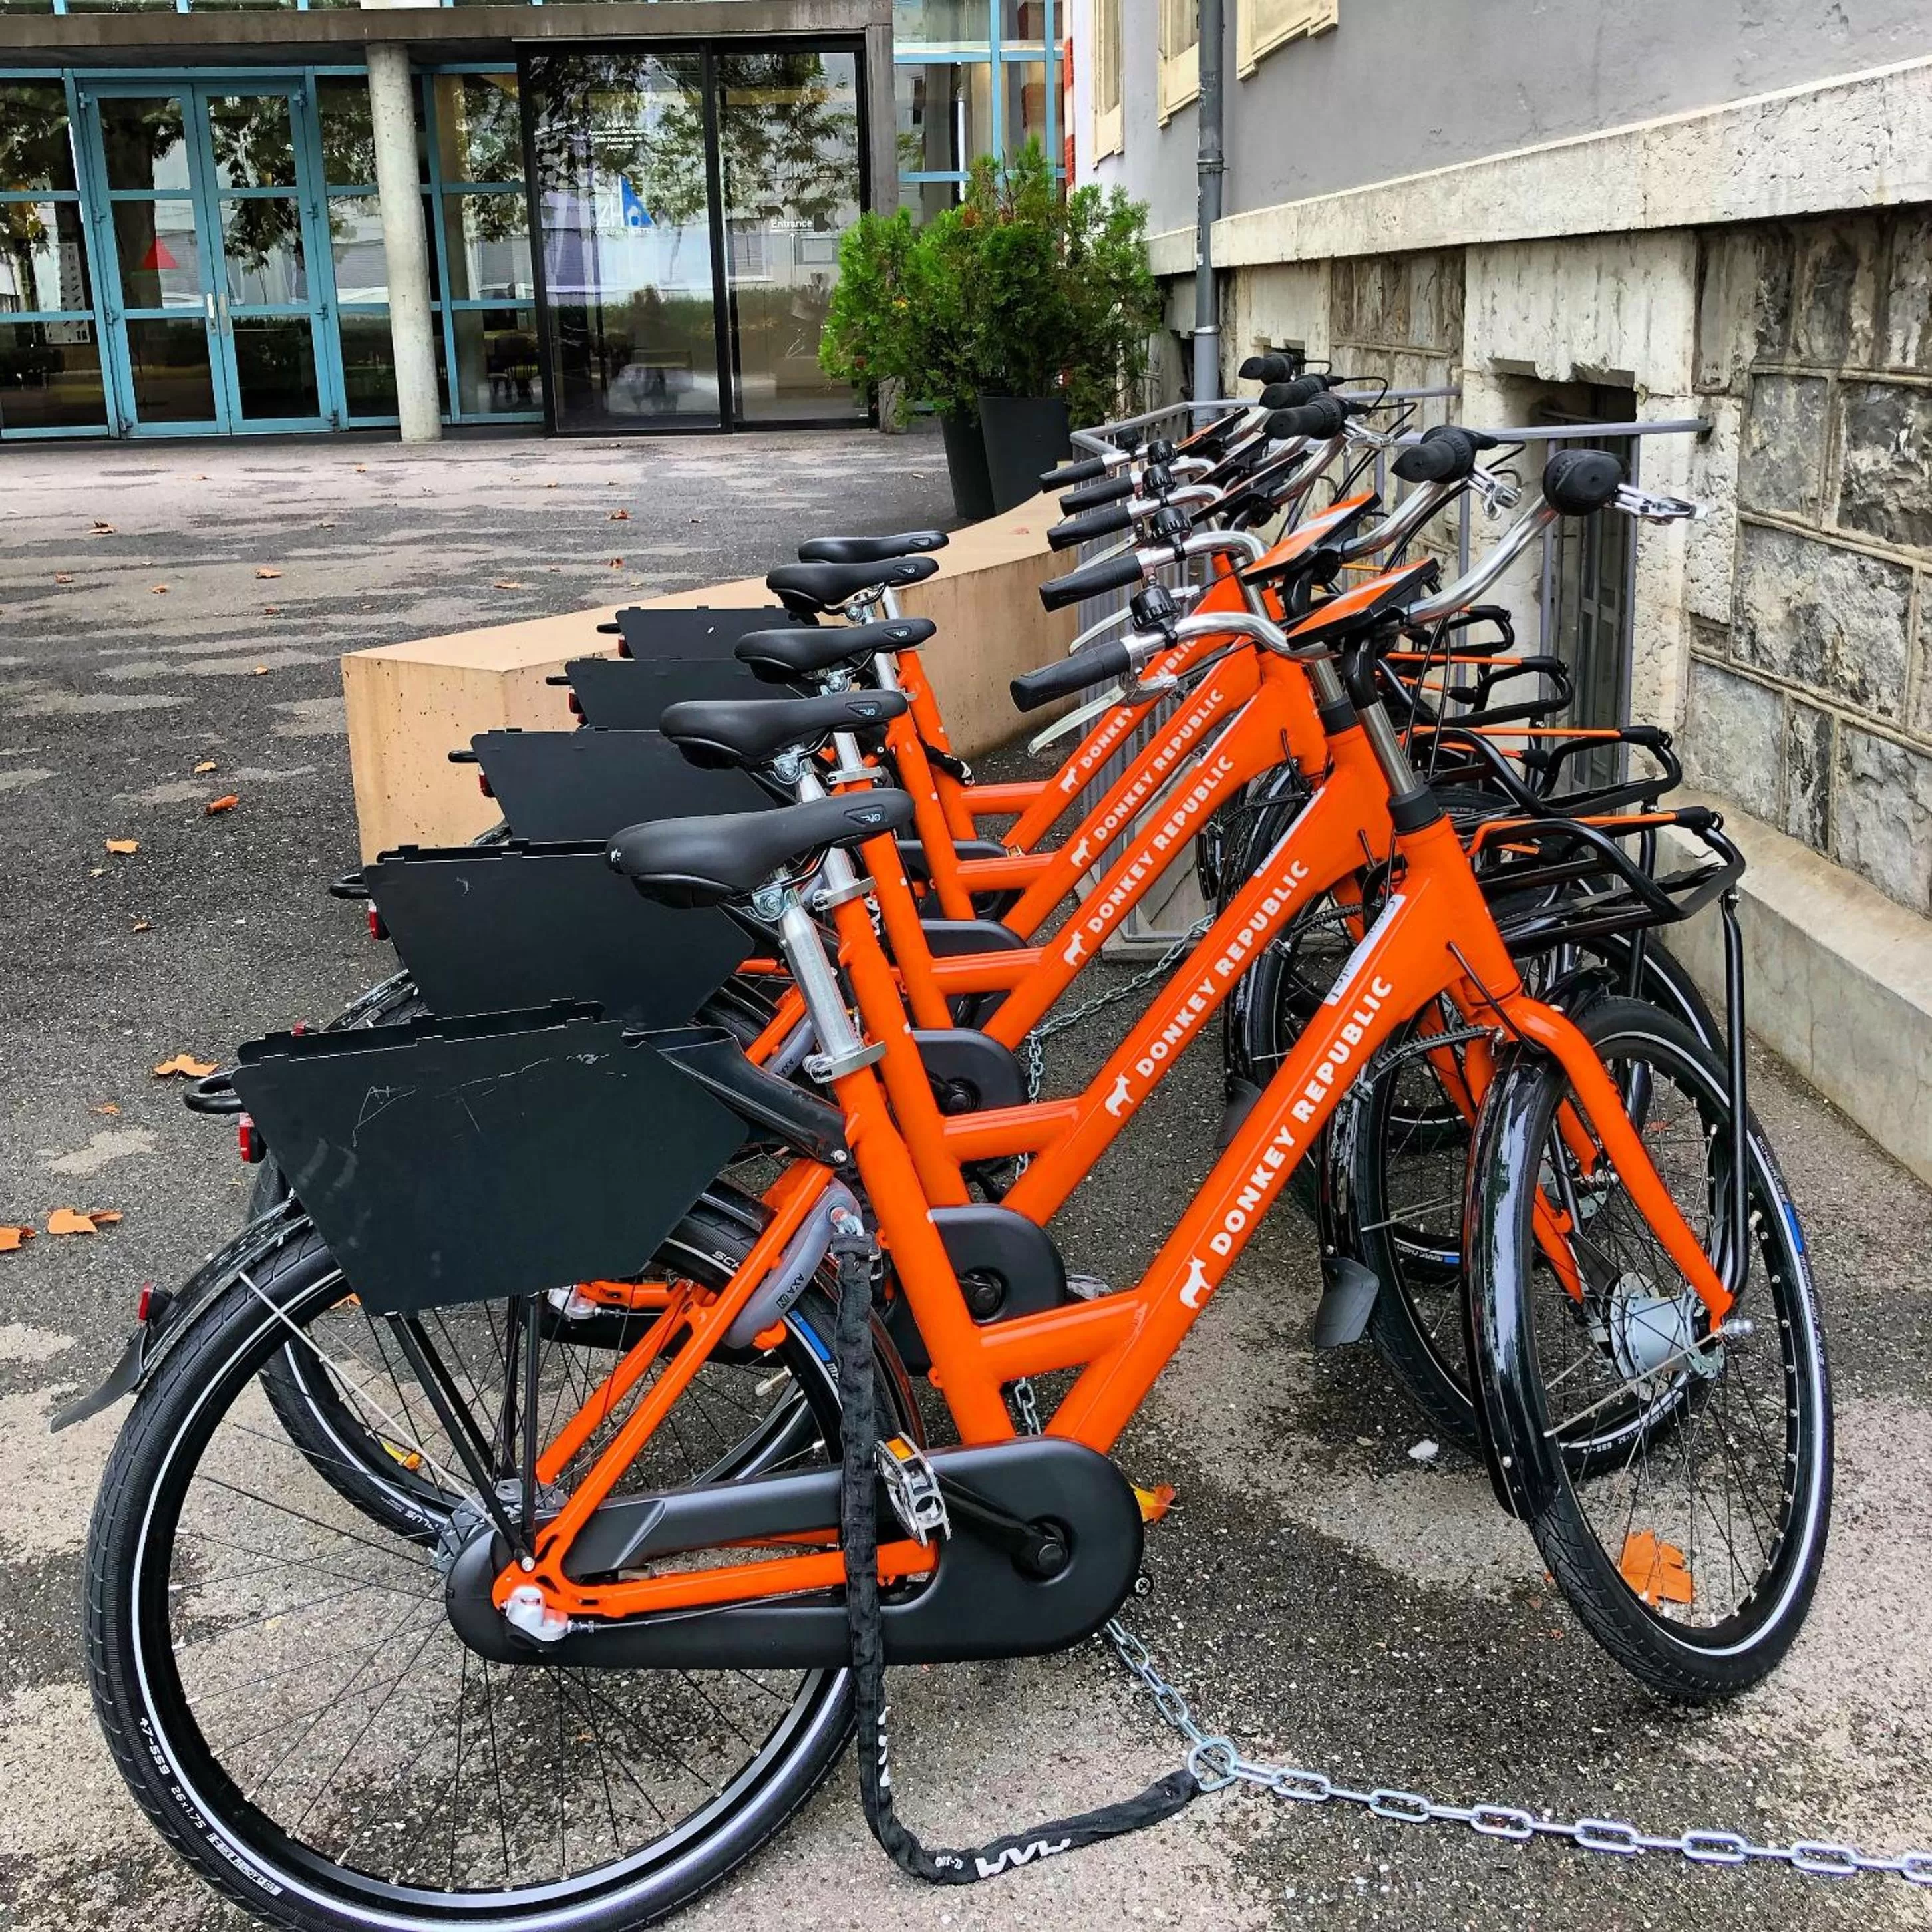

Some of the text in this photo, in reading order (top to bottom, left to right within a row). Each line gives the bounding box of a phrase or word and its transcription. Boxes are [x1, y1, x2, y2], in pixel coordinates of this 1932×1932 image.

[771, 219, 813, 228] Entrance
[1080, 707, 1133, 768] DONKEY
[1092, 689, 1223, 840] DONKEY REPUBLIC
[1088, 756, 1233, 933] DONKEY REPUBLIC
[1136, 860, 1309, 1077] DONKEY REPUBLIC
[1210, 1126, 1295, 1256] DONKEY
[1291, 976, 1392, 1123] REPUBLIC
[786, 1273, 804, 1294] AXA
[170, 1786, 206, 1829] 26x1.75
